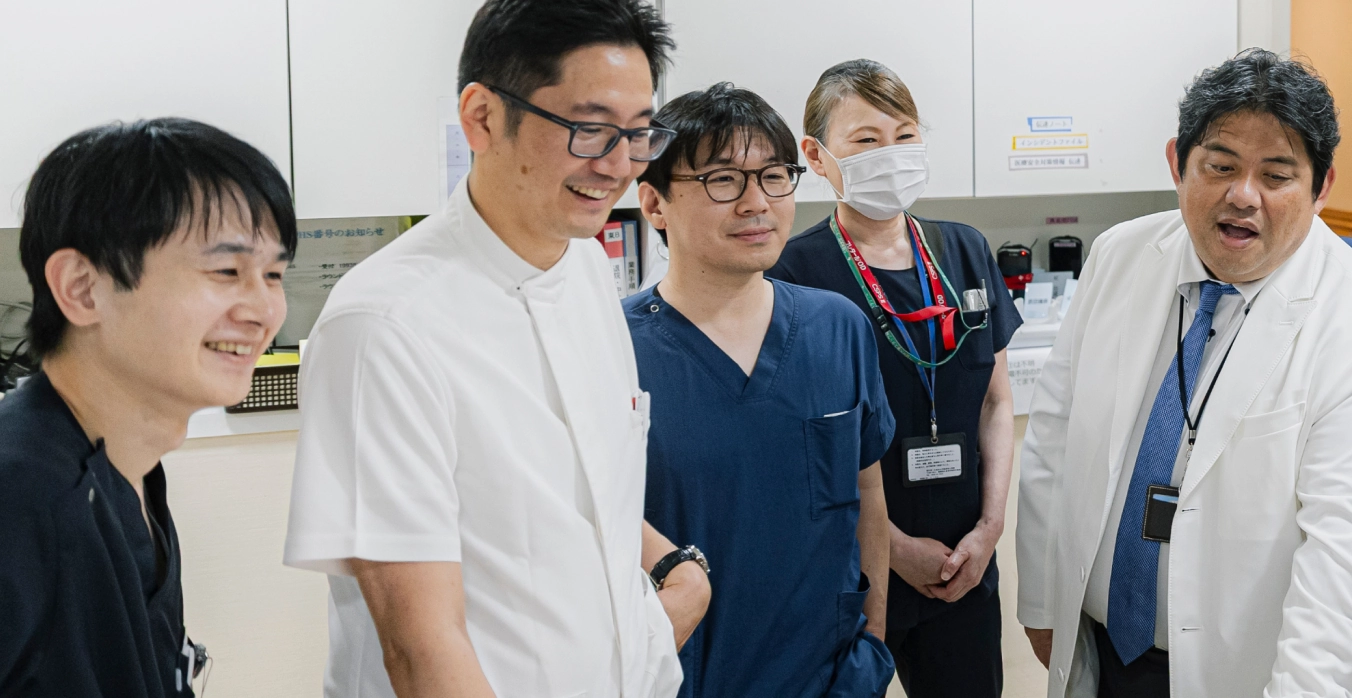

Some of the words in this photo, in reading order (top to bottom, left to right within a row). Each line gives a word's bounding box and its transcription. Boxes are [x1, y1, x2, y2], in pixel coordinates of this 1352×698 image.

[1020, 138, 1083, 147] インシデントファイル
